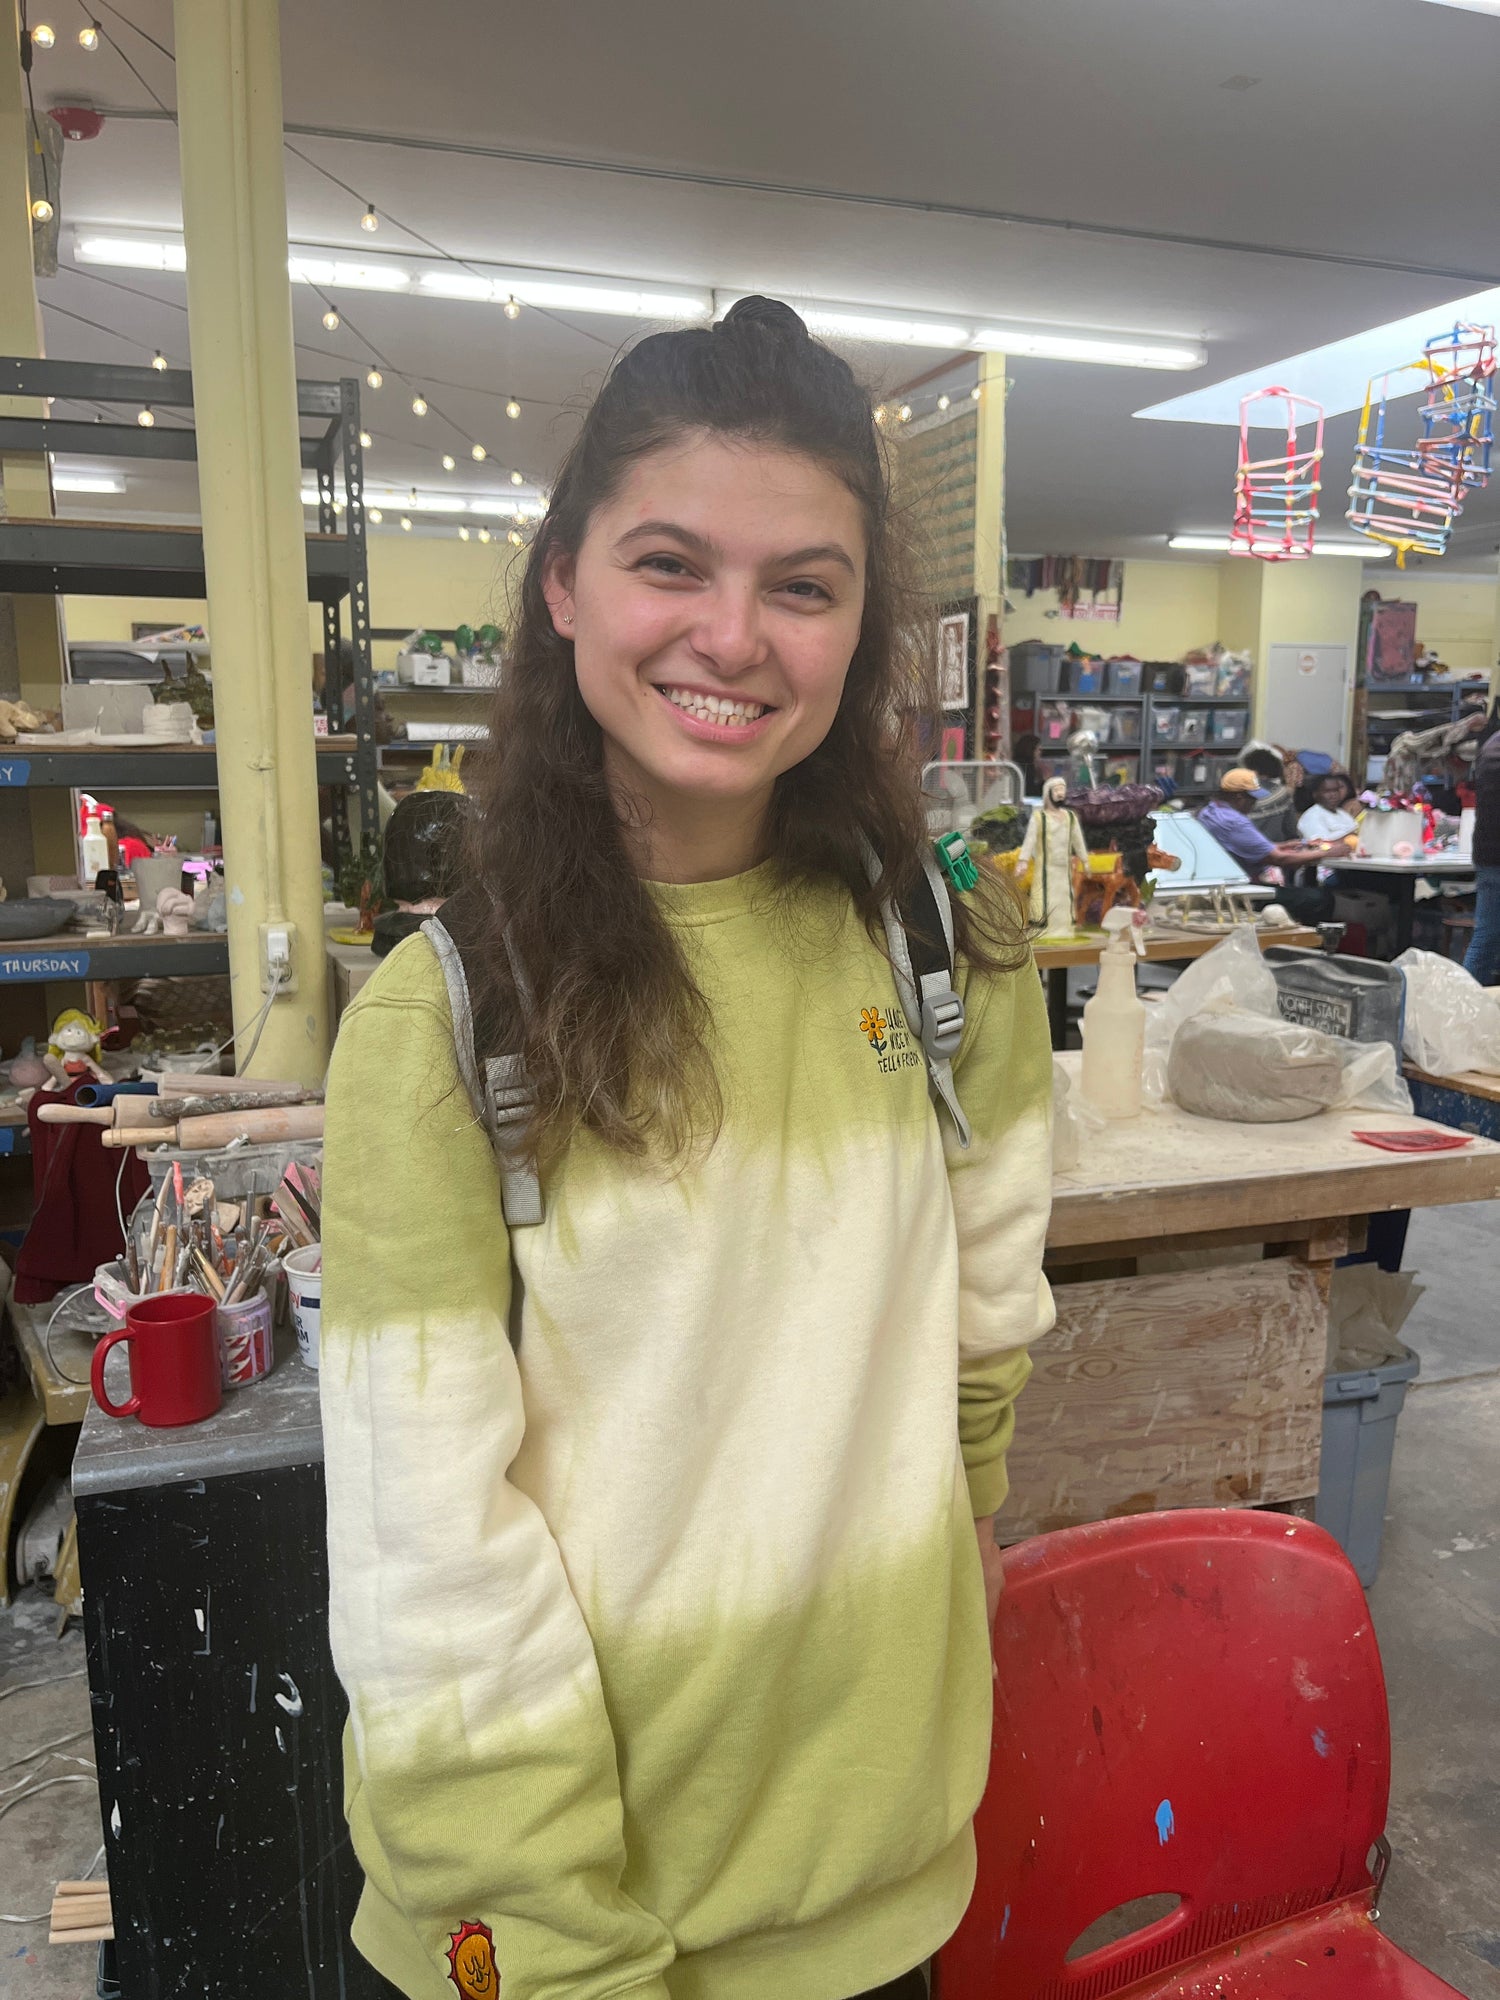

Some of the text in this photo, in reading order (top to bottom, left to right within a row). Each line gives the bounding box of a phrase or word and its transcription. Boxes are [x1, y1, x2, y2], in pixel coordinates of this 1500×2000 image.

[2, 959, 79, 974] THURSDAY
[1315, 1002, 1342, 1021] STAR
[878, 1055, 898, 1073] TELL
